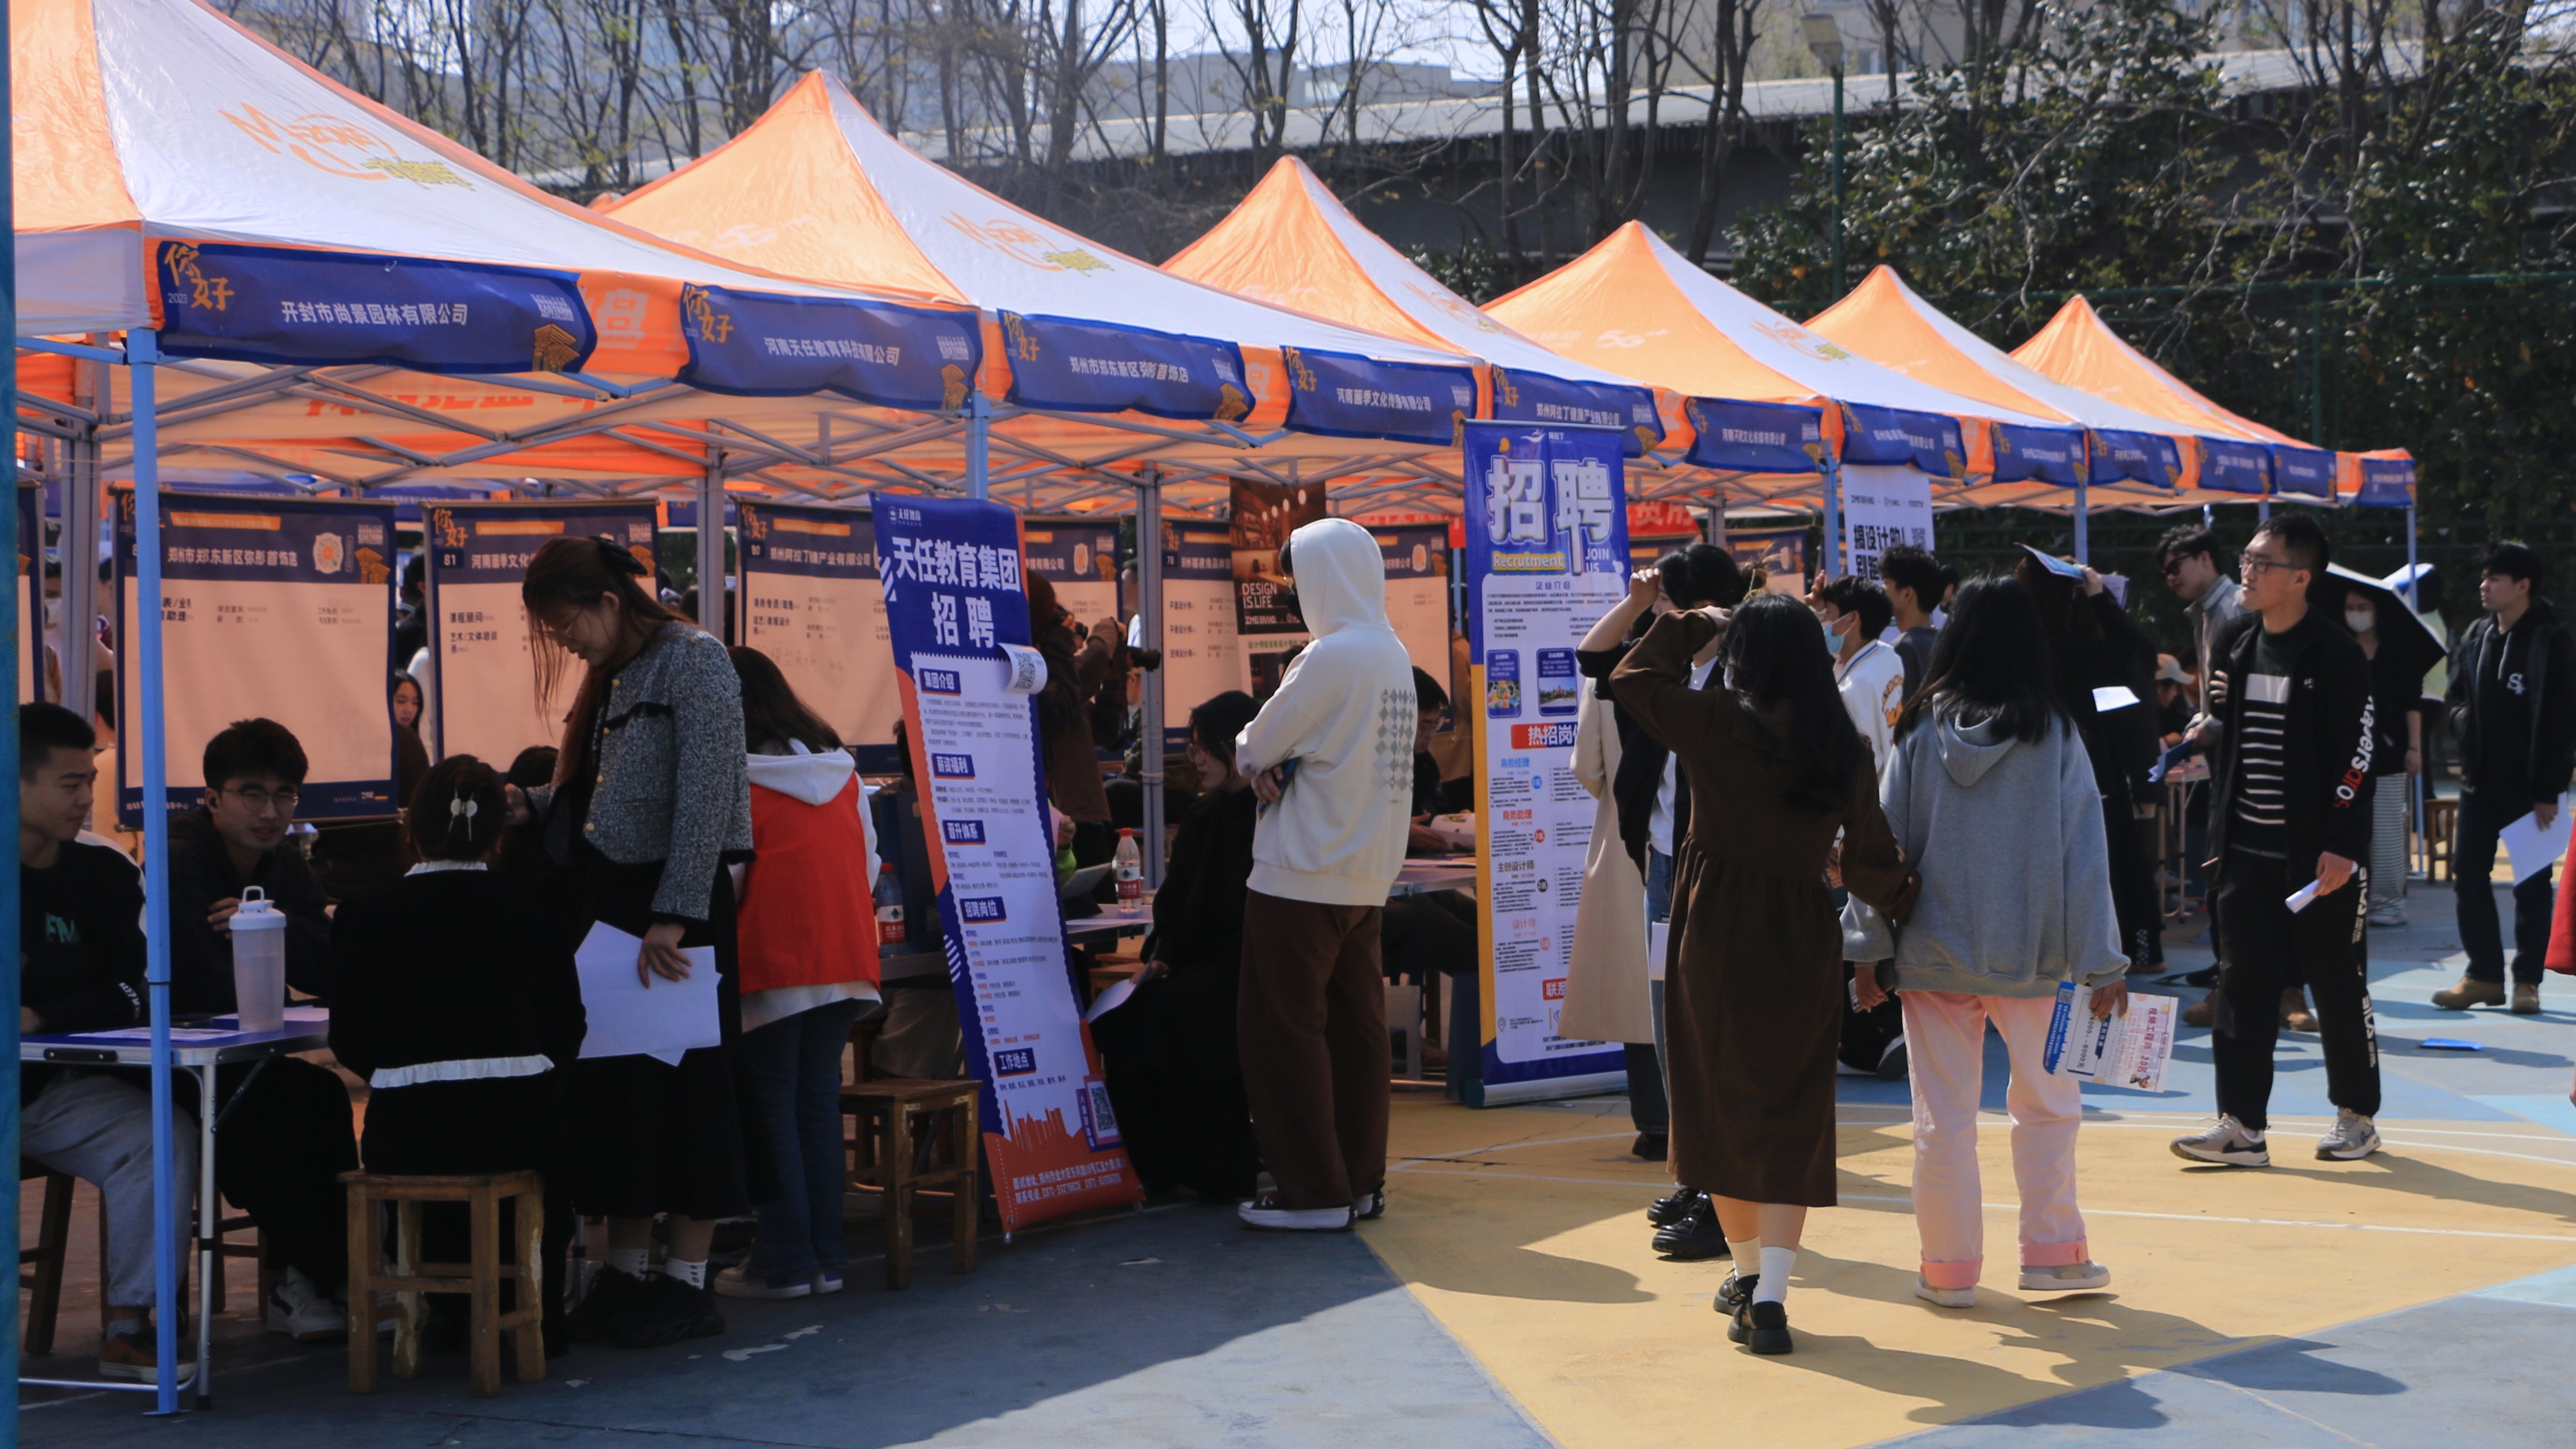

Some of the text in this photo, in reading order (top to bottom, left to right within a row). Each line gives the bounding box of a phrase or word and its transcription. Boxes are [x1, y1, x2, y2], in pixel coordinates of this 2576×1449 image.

[168, 292, 188, 304] 2023
[281, 300, 468, 326] 开封市尚景园林有限公司
[764, 337, 900, 366] 河南天任教育科技有限公司
[1487, 458, 1613, 573] 招聘
[443, 554, 457, 566] 81
[1585, 548, 1609, 560] JOIN
[891, 536, 1022, 593] 天任教育集团
[1586, 562, 1600, 573] US
[1242, 582, 1277, 595] DESIGN
[1243, 596, 1272, 608] IS LIFE
[931, 592, 995, 648] 招聘
[923, 670, 955, 690] 集团介绍
[947, 822, 978, 840] 晋升体系
[1498, 860, 1534, 872] 主创设计师
[964, 899, 999, 918] 招聘岗位
[999, 1051, 1030, 1071] 工作地点
